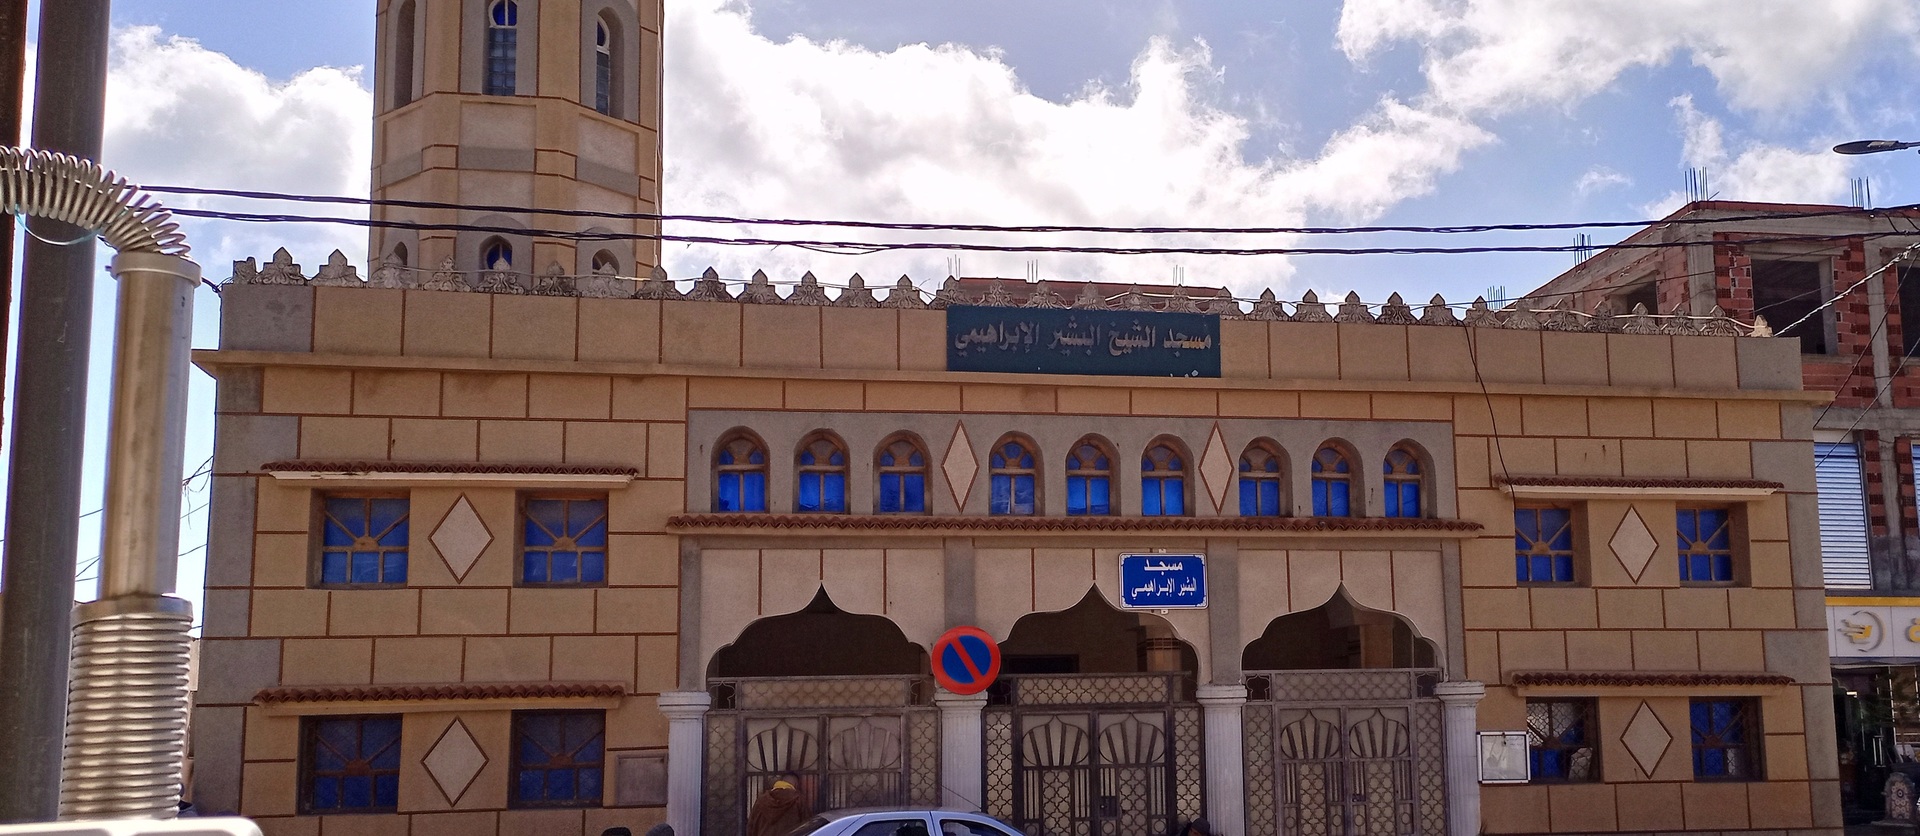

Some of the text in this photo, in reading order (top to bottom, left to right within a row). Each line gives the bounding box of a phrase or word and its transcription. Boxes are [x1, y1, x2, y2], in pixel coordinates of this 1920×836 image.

[954, 315, 1212, 358] مسجد الشيخ البشير الإبراهيمي
[1144, 559, 1183, 576] مسجد
[1177, 576, 1197, 597] البشير
